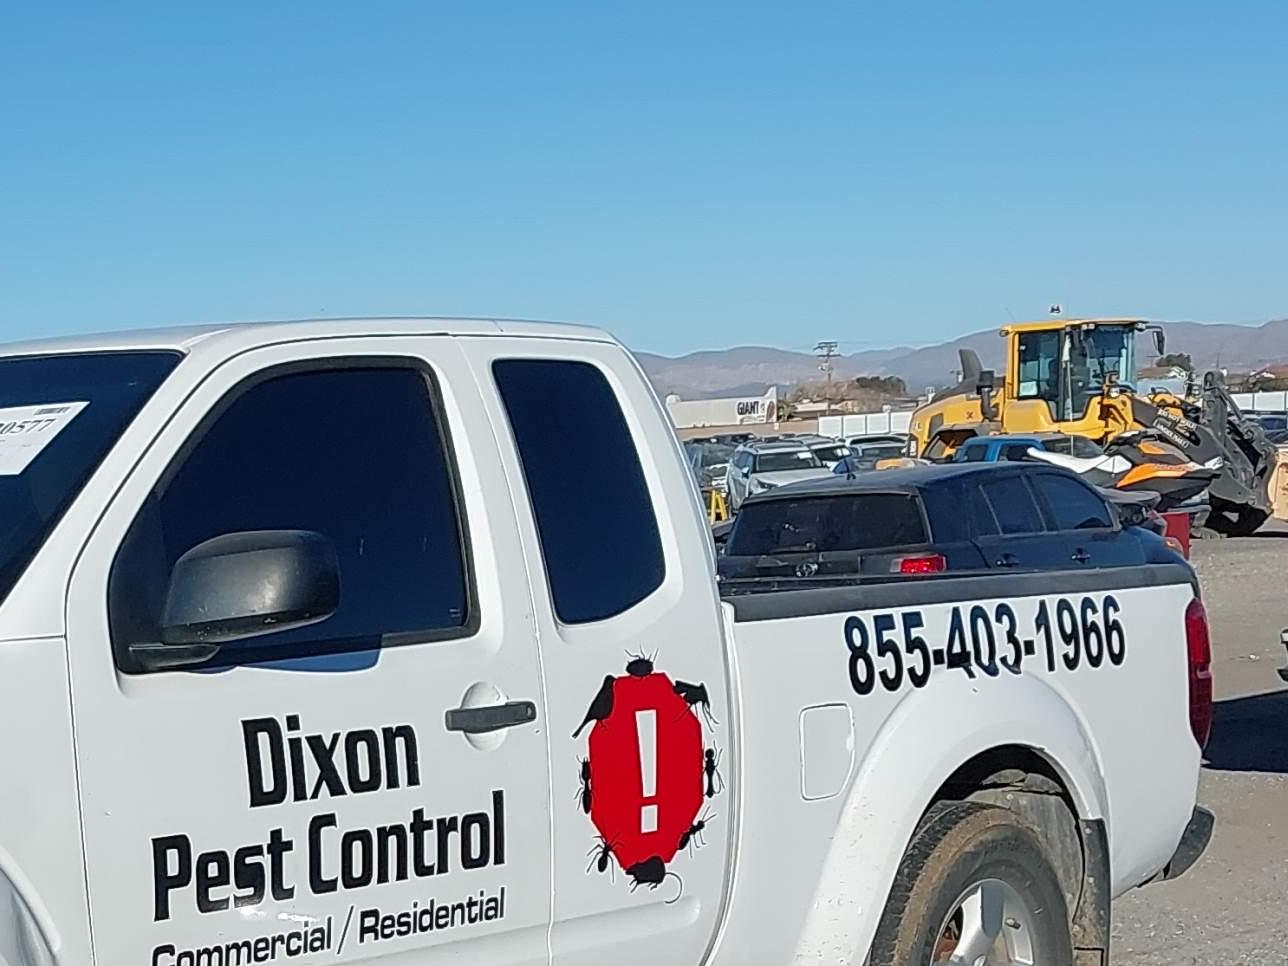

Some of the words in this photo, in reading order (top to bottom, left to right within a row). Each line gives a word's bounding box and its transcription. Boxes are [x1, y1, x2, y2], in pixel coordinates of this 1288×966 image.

[844, 595, 1126, 695] 855-403-1966
[241, 714, 420, 808] Dixon
[151, 828, 294, 921] Pest
[309, 790, 505, 895] Control
[360, 887, 505, 943] Residential
